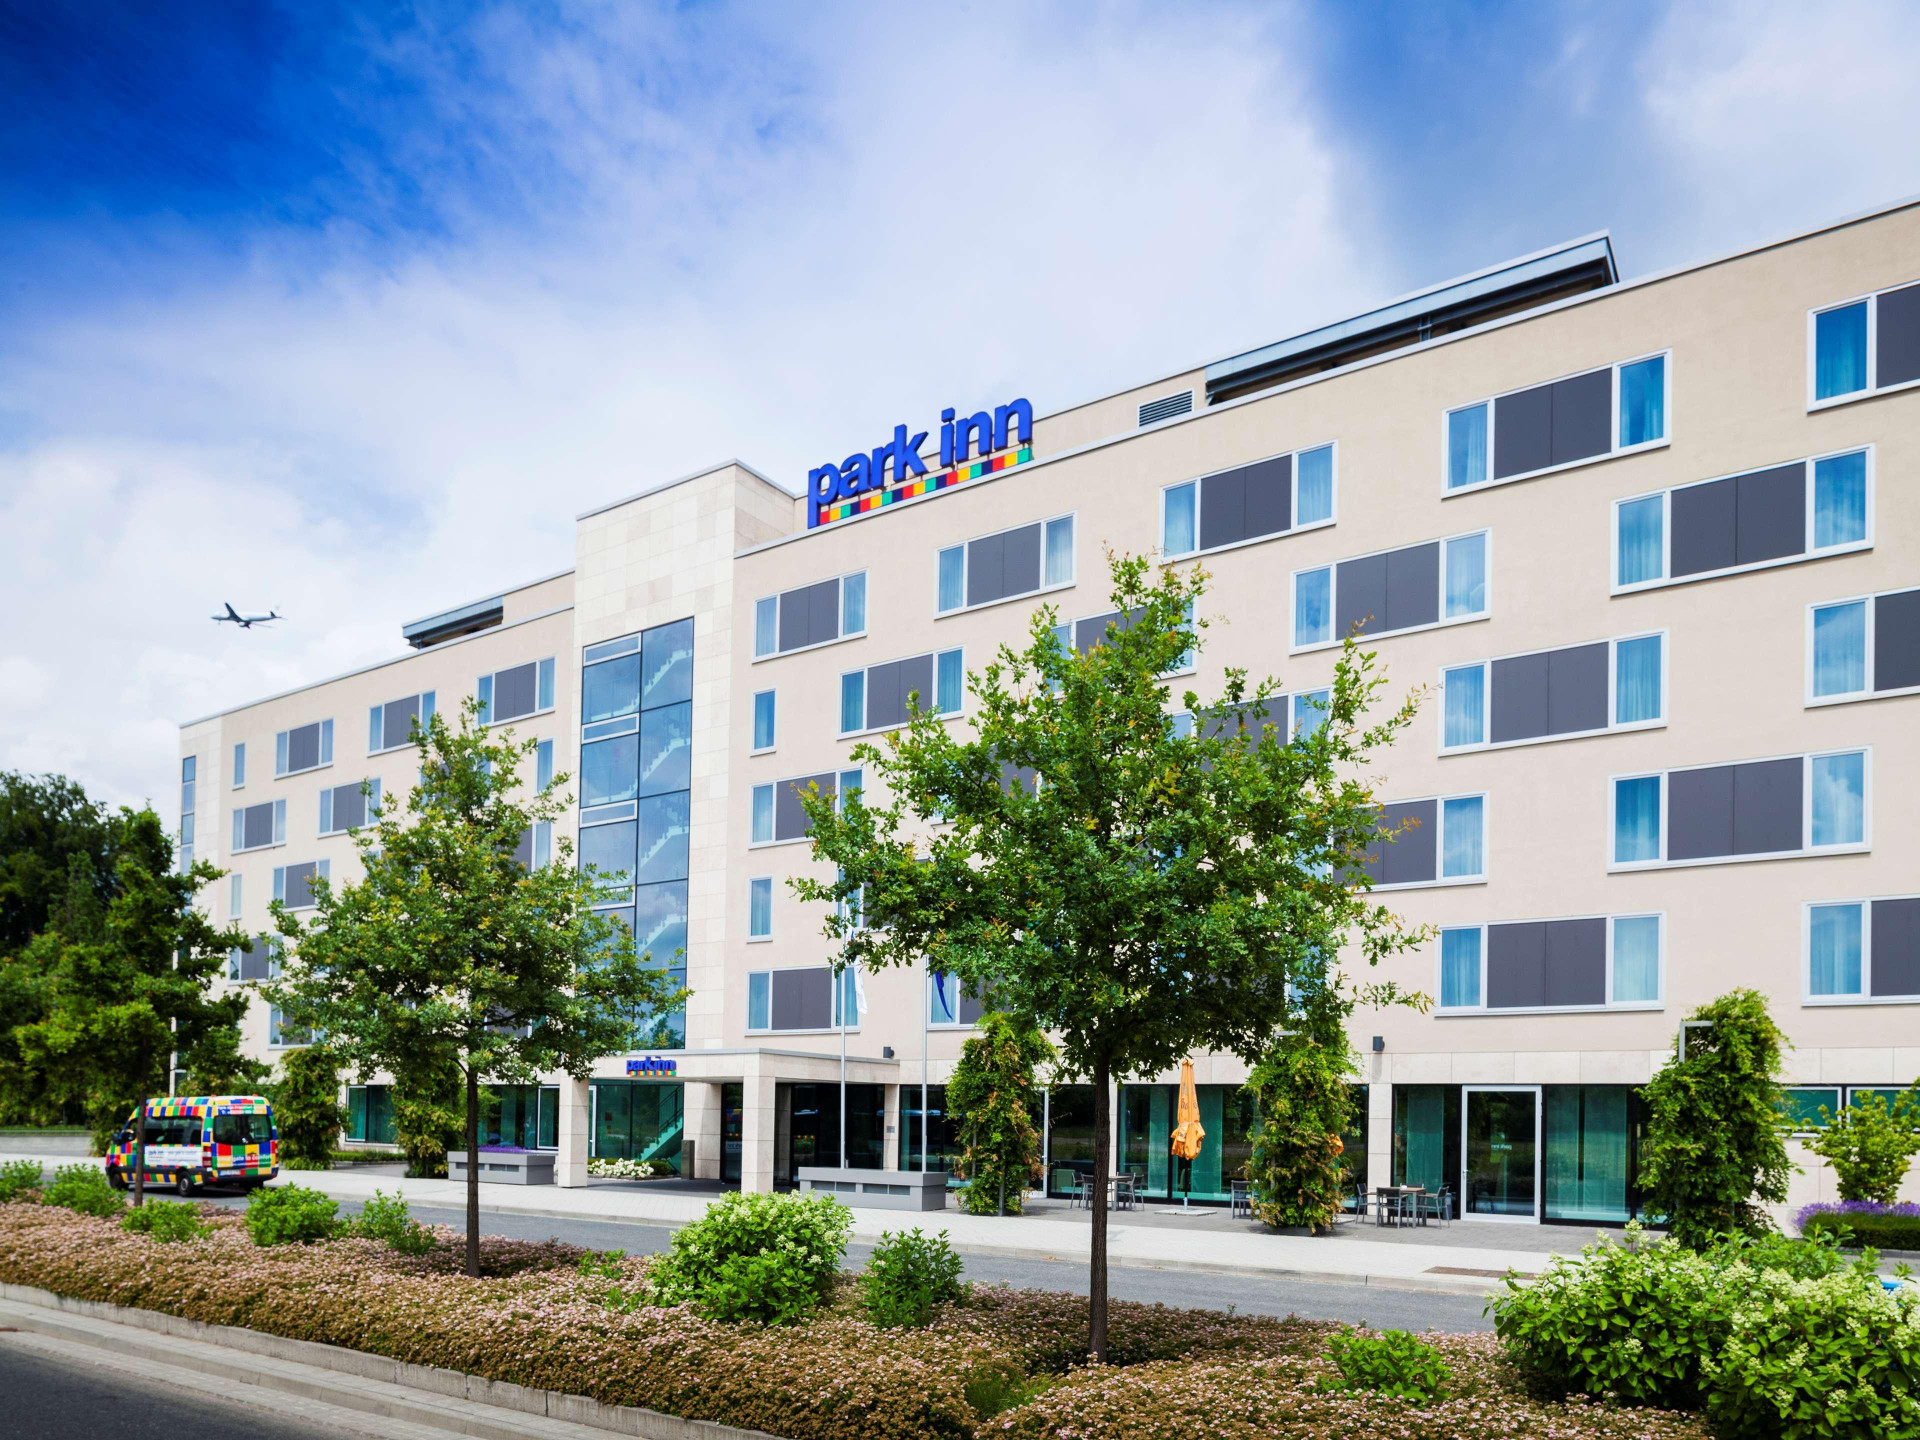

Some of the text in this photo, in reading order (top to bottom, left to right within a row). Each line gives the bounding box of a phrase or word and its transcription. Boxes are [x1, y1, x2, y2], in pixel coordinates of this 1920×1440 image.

[808, 398, 1033, 529] park inn
[626, 1056, 677, 1075] park inn
